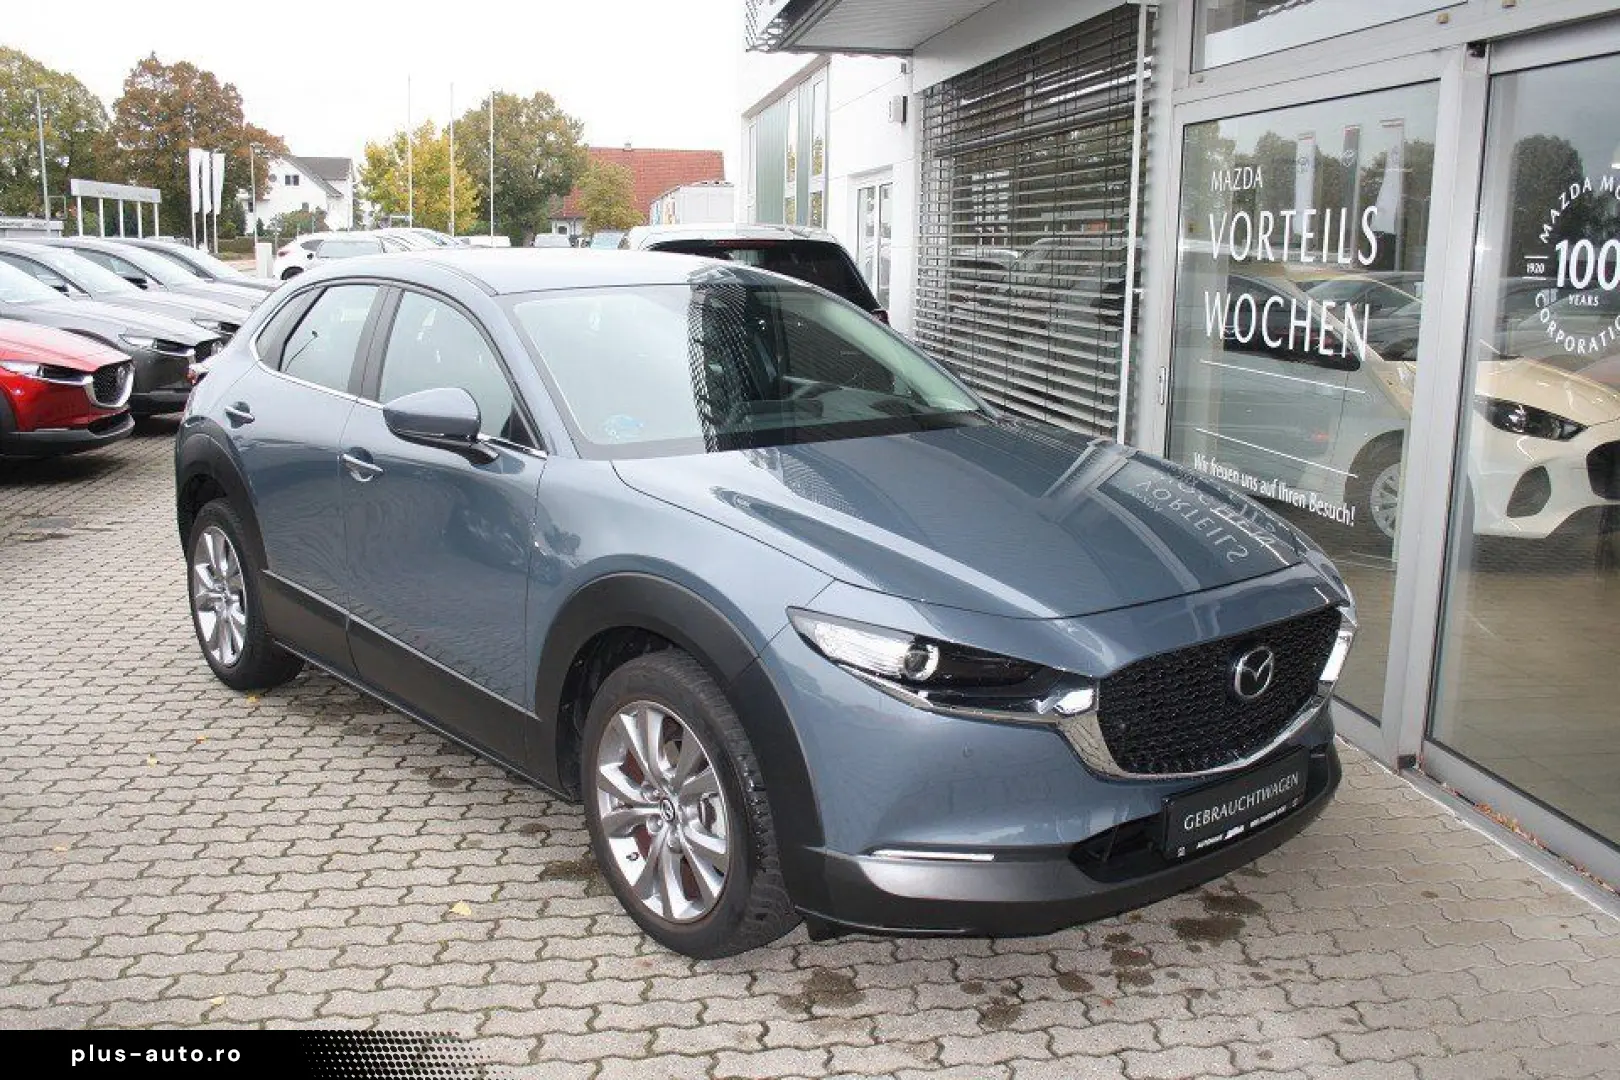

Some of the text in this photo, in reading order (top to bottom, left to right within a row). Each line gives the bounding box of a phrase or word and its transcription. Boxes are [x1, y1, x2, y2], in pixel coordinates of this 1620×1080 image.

[1211, 167, 1264, 191] MAZDA
[1209, 205, 1378, 266] VORTEILS
[1539, 176, 1592, 244] MAZDA
[1526, 262, 1545, 274] 1920
[1555, 238, 1620, 291] 100
[1204, 291, 1370, 361] WOCHEN
[1568, 293, 1599, 307] YEARS
[1194, 452, 1356, 527] Wir freuen uns auf Ihren Besuch!
[1183, 771, 1300, 831] GEBRAUCHTWAGEN
